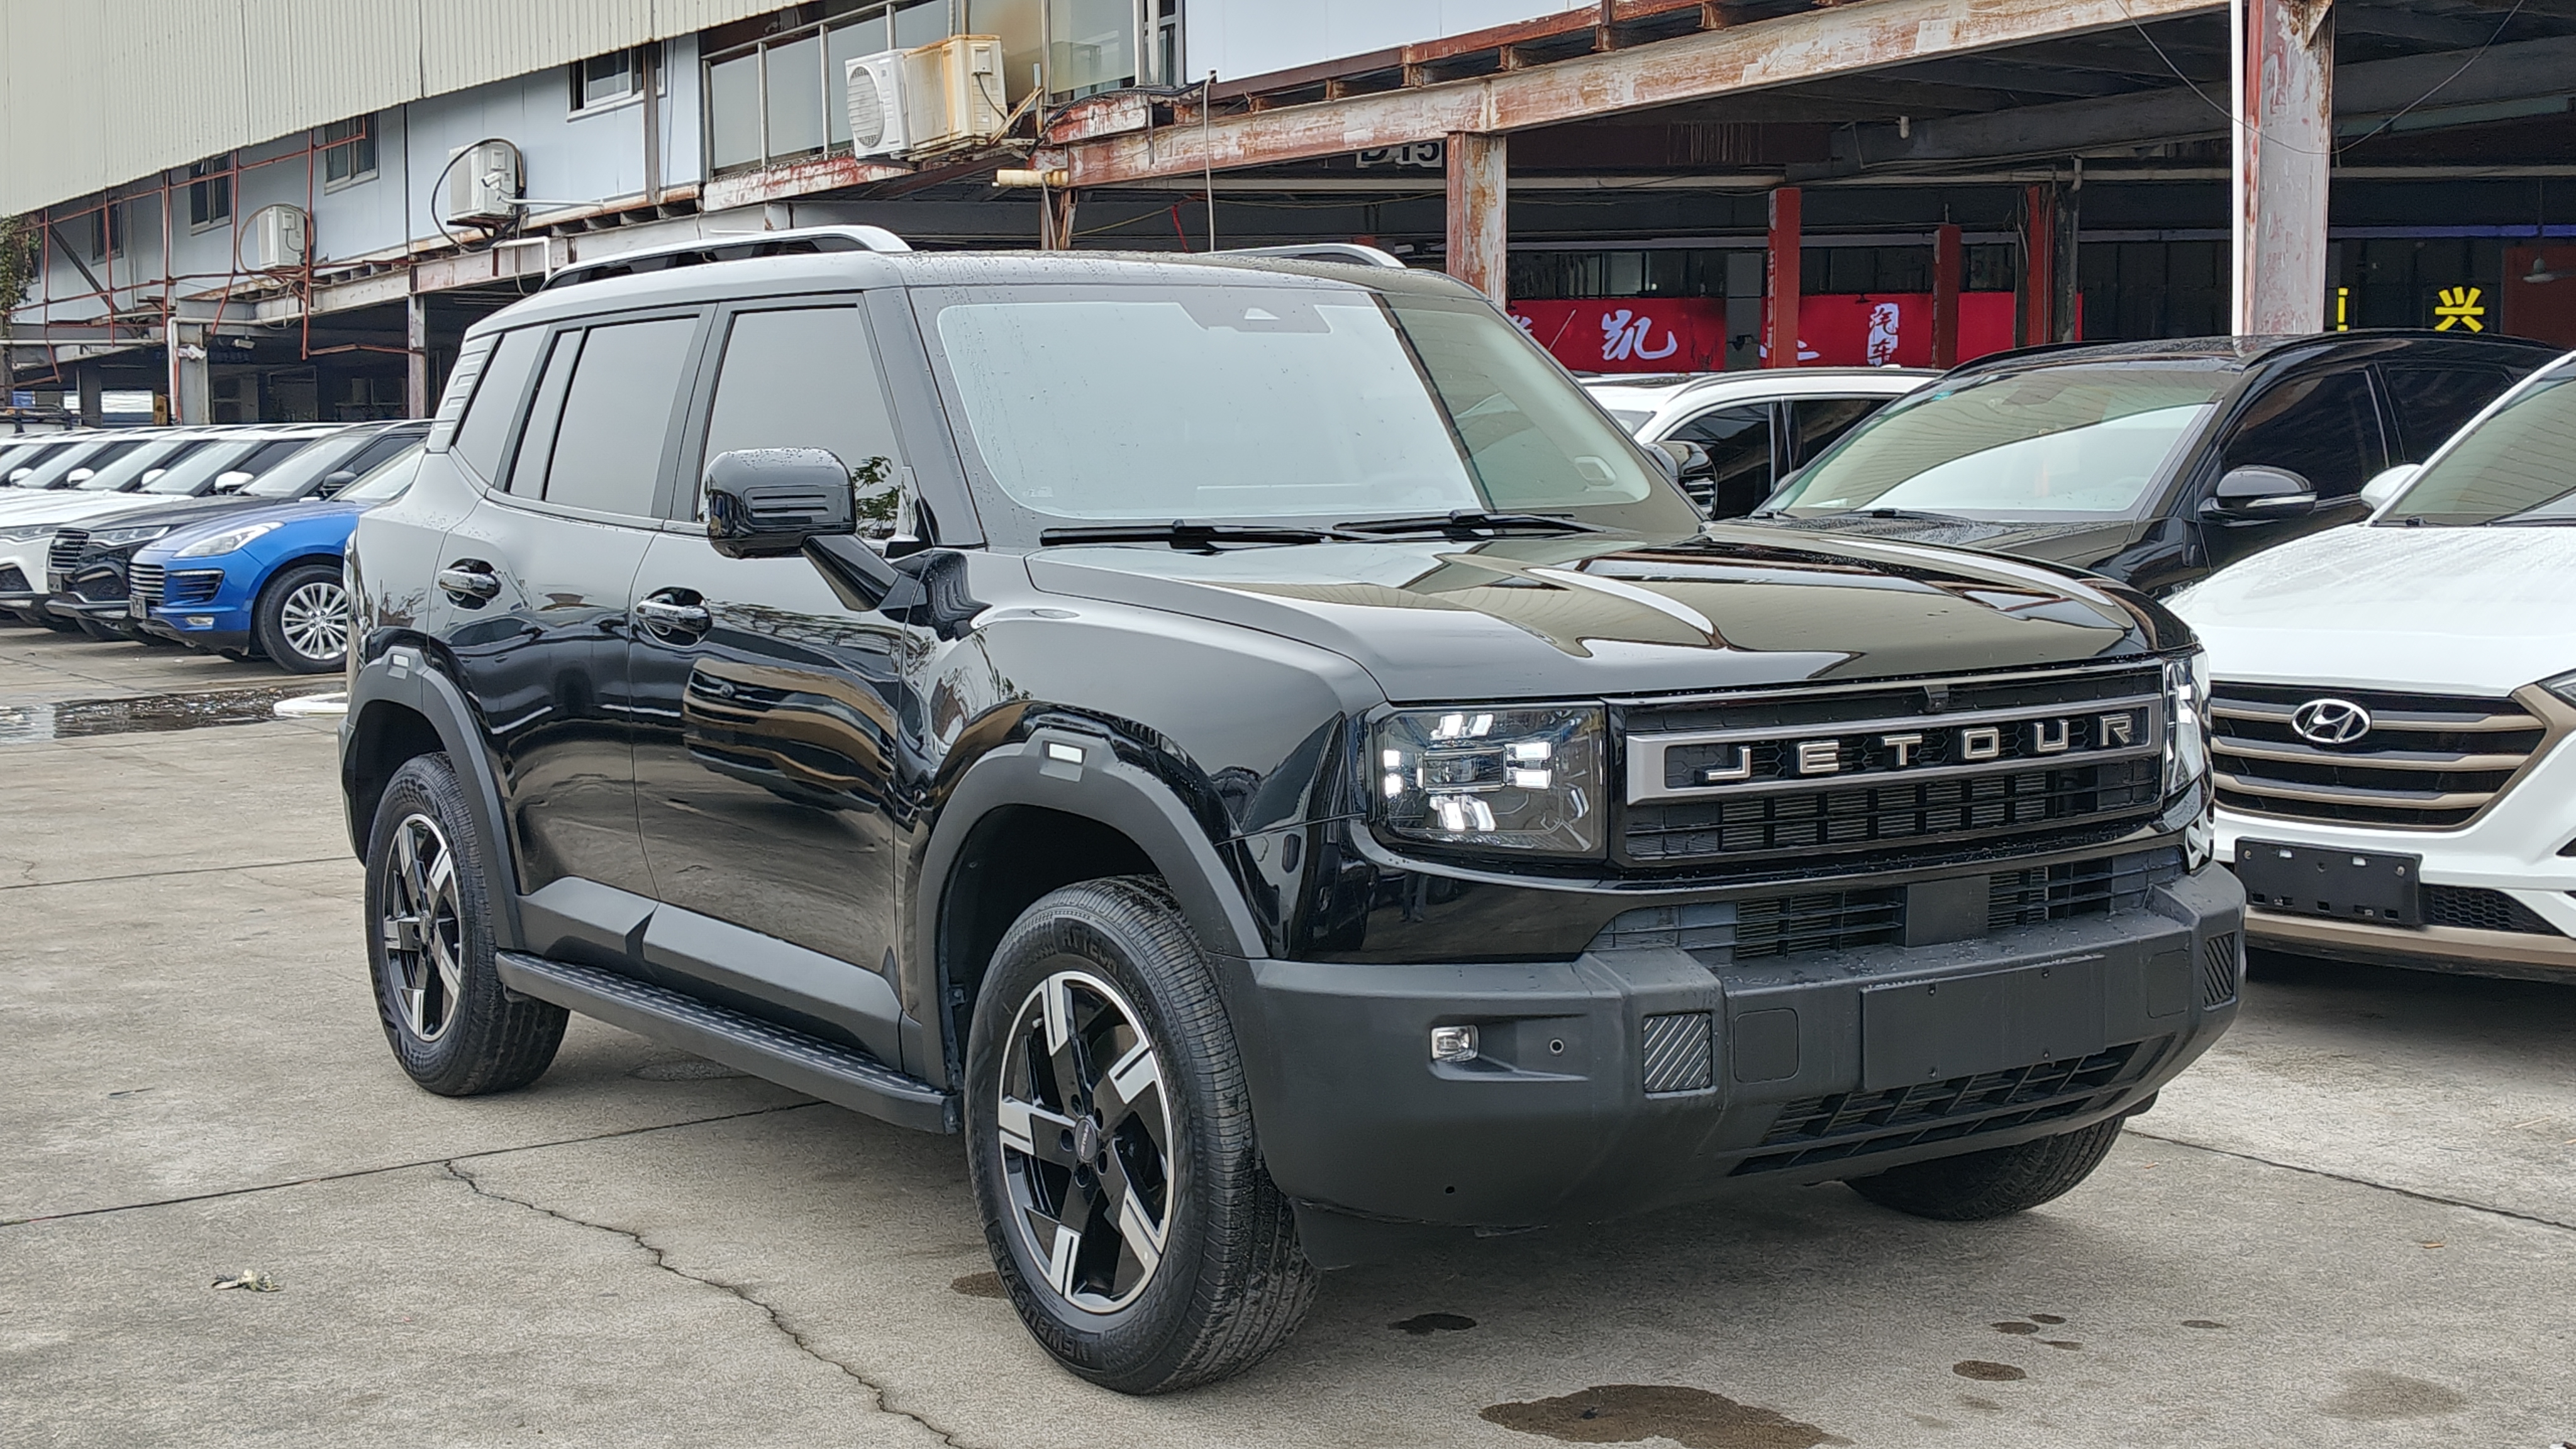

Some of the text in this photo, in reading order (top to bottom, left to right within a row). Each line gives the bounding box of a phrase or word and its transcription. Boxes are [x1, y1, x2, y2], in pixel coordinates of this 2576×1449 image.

[1601, 309, 1678, 360] 凯
[2434, 286, 2485, 333] 兴
[1698, 713, 2134, 782] JETOUR
